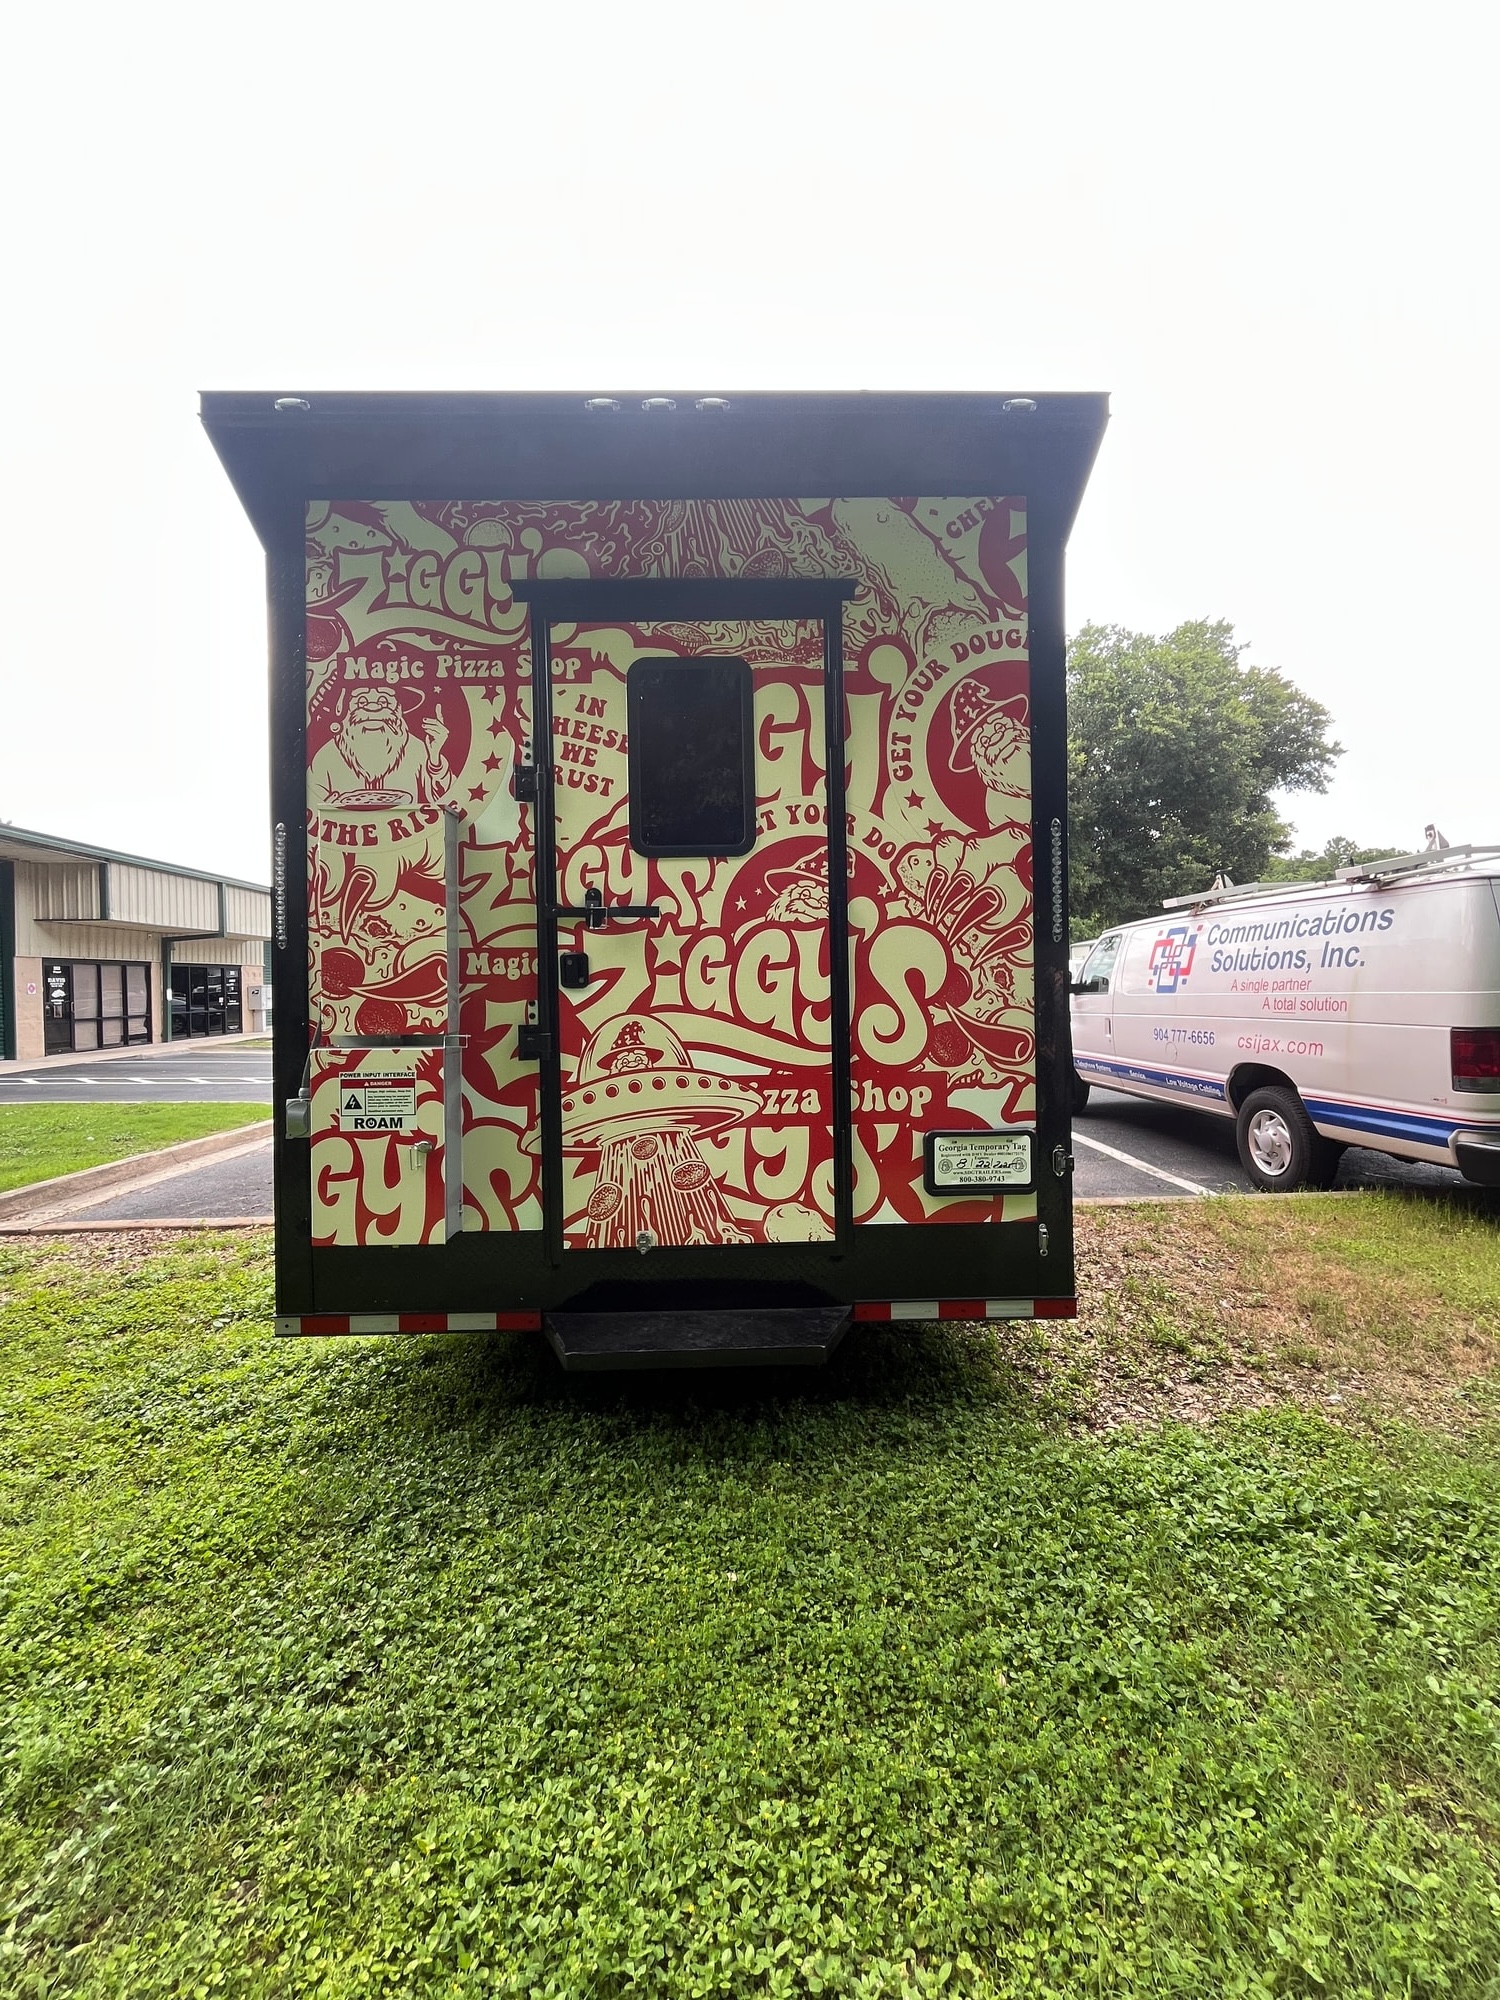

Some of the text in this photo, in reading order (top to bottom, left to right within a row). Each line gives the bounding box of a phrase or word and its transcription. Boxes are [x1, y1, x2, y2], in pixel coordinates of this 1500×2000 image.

[946, 497, 1005, 538] CHE
[344, 655, 582, 683] Magic Pizza Sop
[896, 659, 949, 722] YOUR
[575, 694, 607, 718] IN
[552, 716, 629, 754] HEESE
[560, 742, 598, 767] WE
[891, 732, 913, 782] GET
[553, 765, 614, 797] RUST
[321, 819, 378, 846] THE
[1207, 908, 1395, 946] Communications
[1211, 941, 1365, 973] Solutions, Inc.
[1231, 978, 1312, 993] A single partner
[1262, 997, 1348, 1012] A total solution
[1153, 1028, 1215, 1045] 904 777-6656
[1237, 1034, 1324, 1056] csijax.com
[1166, 1078, 1177, 1086] Low
[354, 1117, 403, 1129] ROAM
[939, 1143, 1027, 1152] Georgia Temporary Tag
